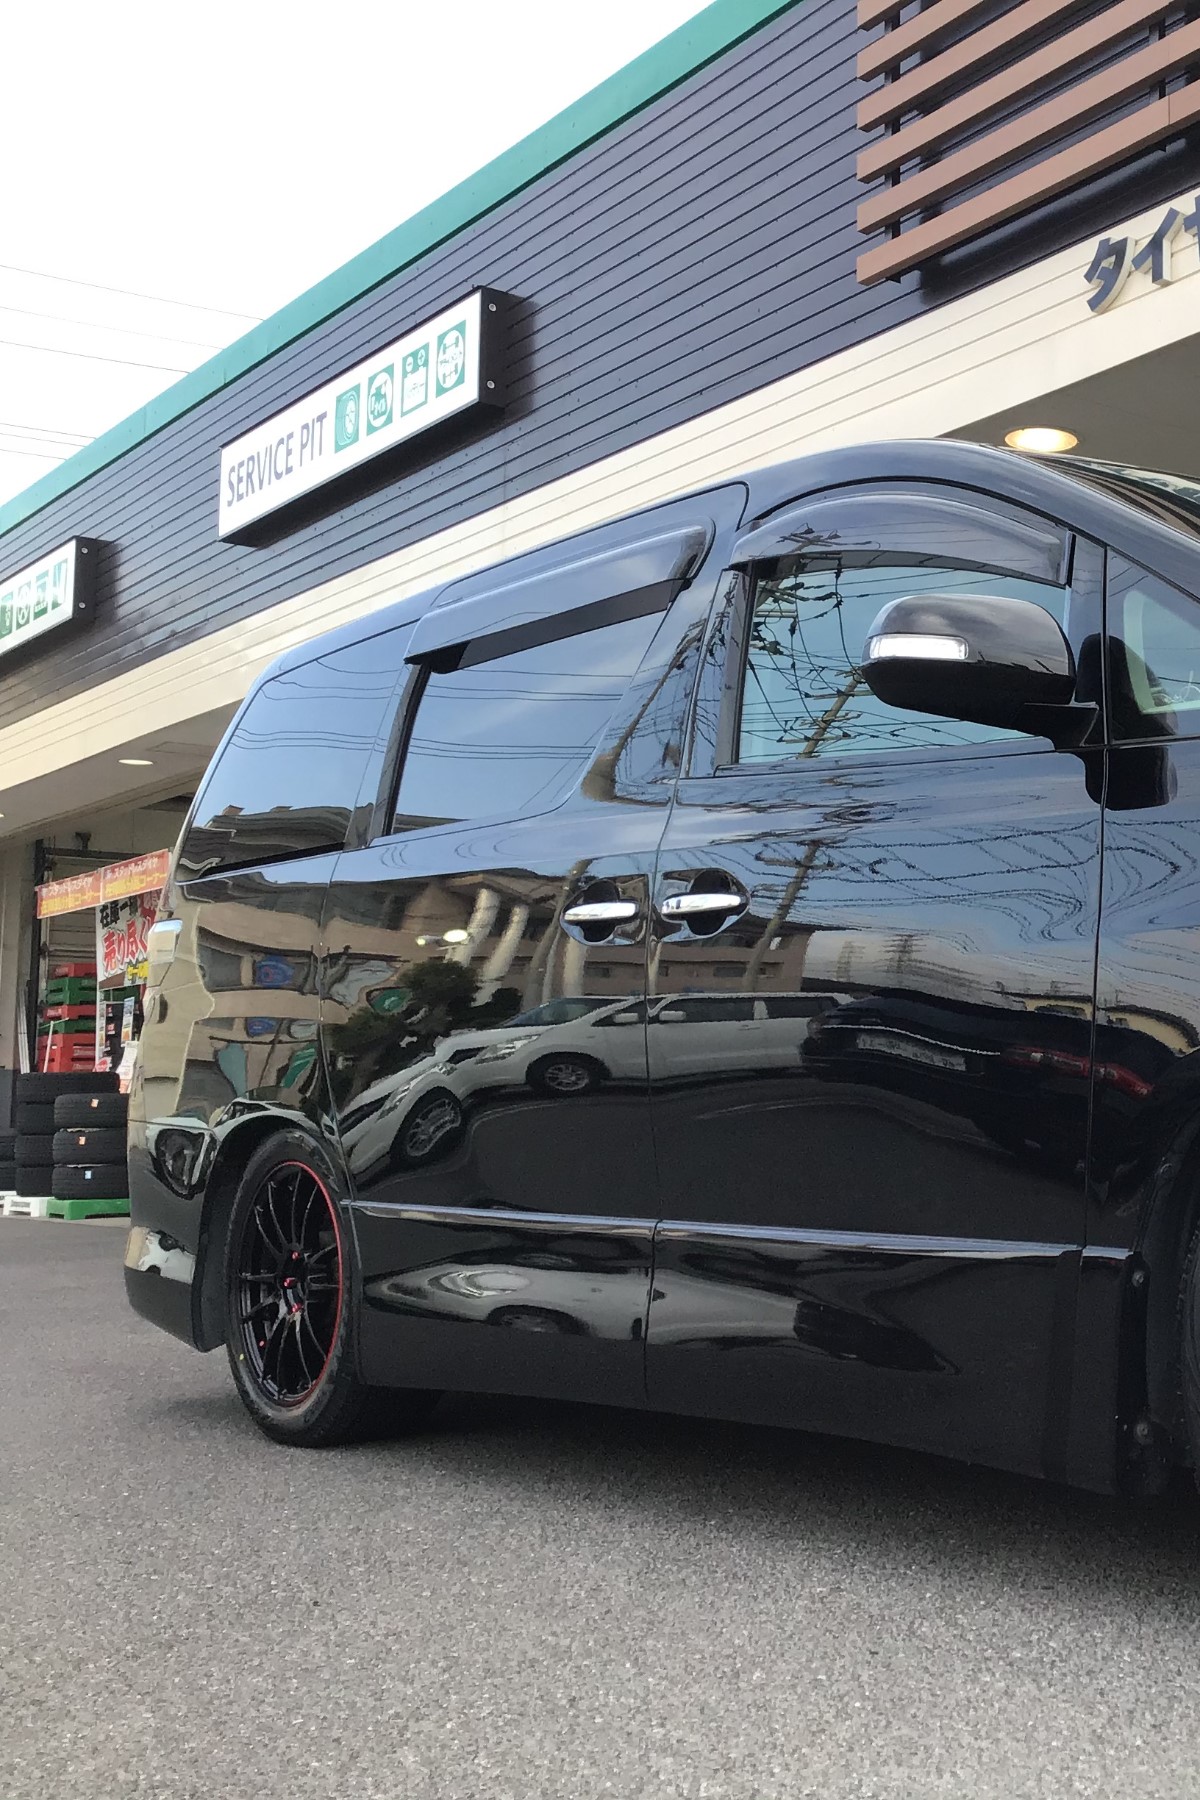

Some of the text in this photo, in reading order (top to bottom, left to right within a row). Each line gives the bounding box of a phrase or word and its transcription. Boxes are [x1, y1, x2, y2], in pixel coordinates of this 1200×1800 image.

[227, 411, 328, 507] SERVICE PIT
[103, 918, 150, 977] 売り尽く
